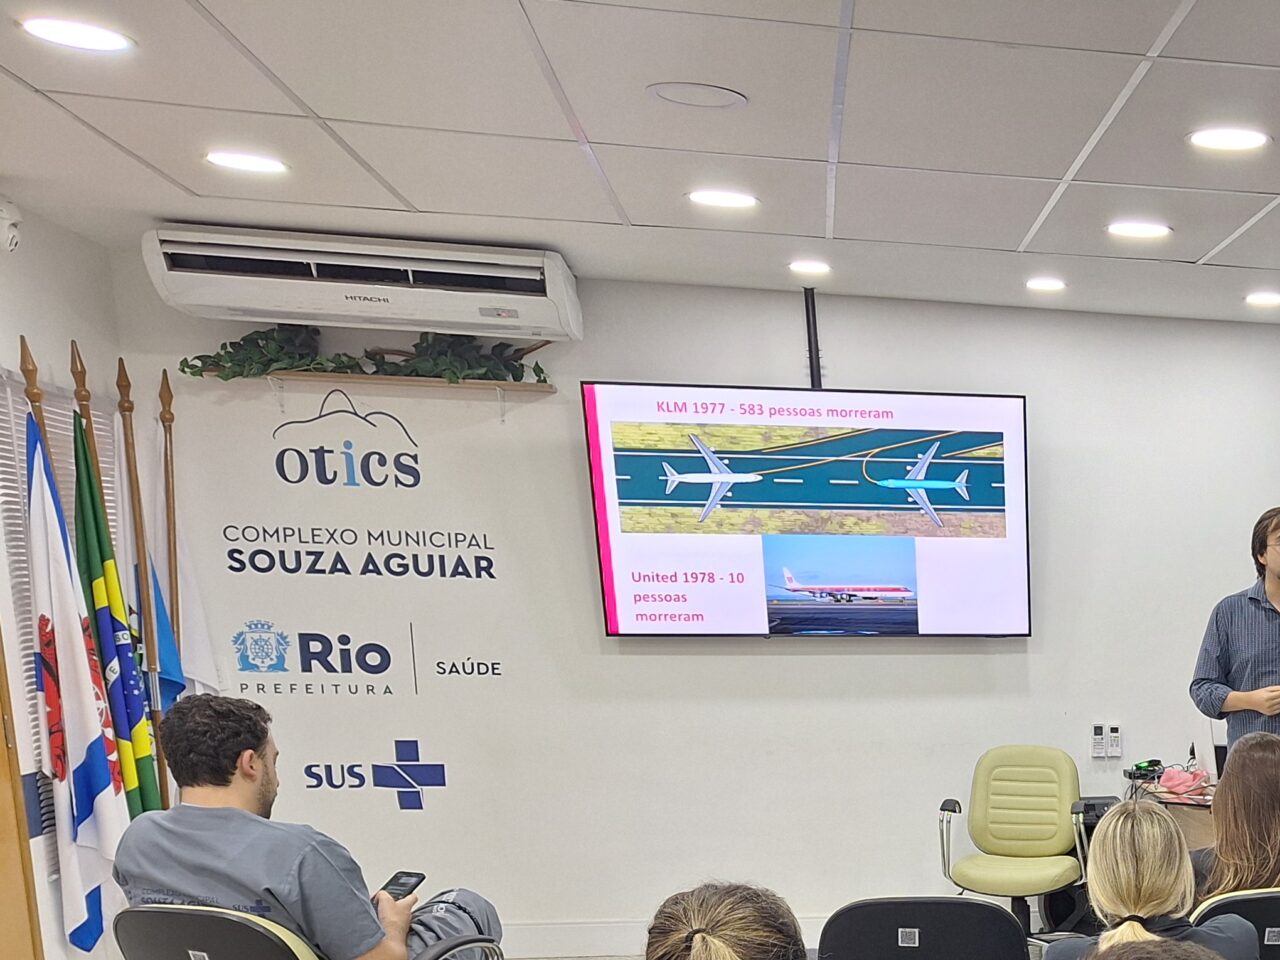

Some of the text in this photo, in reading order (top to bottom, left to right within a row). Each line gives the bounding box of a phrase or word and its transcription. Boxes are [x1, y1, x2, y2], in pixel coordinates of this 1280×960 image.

[345, 295, 389, 303] HITACHI
[657, 401, 687, 413] KLM
[692, 402, 725, 414] 1977
[739, 403, 764, 415] 583
[768, 405, 822, 418] pessoas
[826, 408, 894, 419] morreram
[276, 440, 421, 488] otics
[223, 525, 495, 550] COMPLEXO MUNICIPAL
[227, 548, 497, 579] SOUZA AGUIAR
[631, 571, 678, 583] United
[683, 572, 715, 583] 1978
[729, 572, 744, 583] 10
[633, 593, 687, 605] pessoas
[635, 613, 704, 622] morreram
[298, 632, 391, 674] Rio
[436, 657, 502, 676] SAÚDE
[240, 683, 393, 696] PREFEITURA
[304, 764, 365, 789] SUS
[232, 904, 250, 912] SUS
